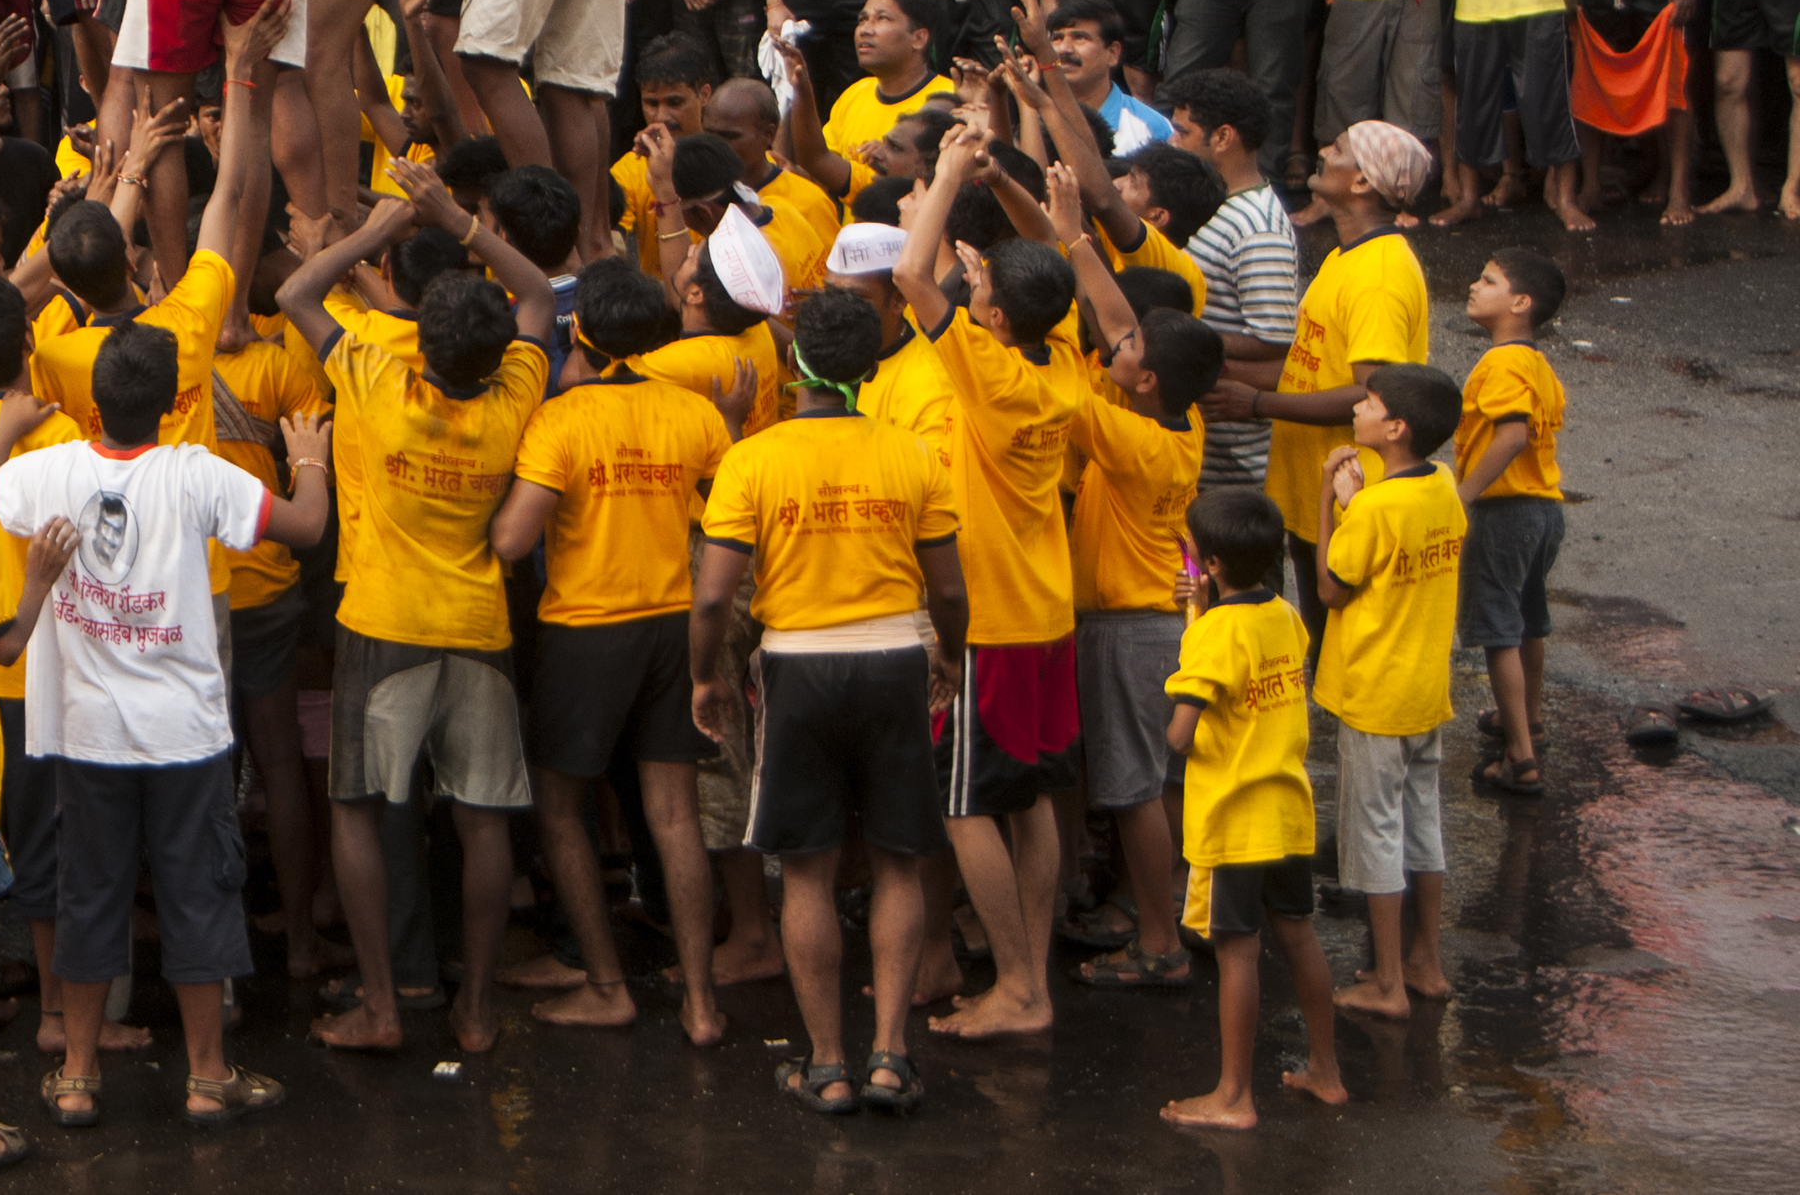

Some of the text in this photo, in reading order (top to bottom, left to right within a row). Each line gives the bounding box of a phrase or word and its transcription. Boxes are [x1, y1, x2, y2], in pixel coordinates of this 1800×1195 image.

[422, 464, 463, 493] भरत
[816, 480, 860, 497] सौजन्य
[779, 498, 807, 527] श्री.
[812, 500, 849, 524] भरत
[135, 624, 184, 654] भुजबळ
